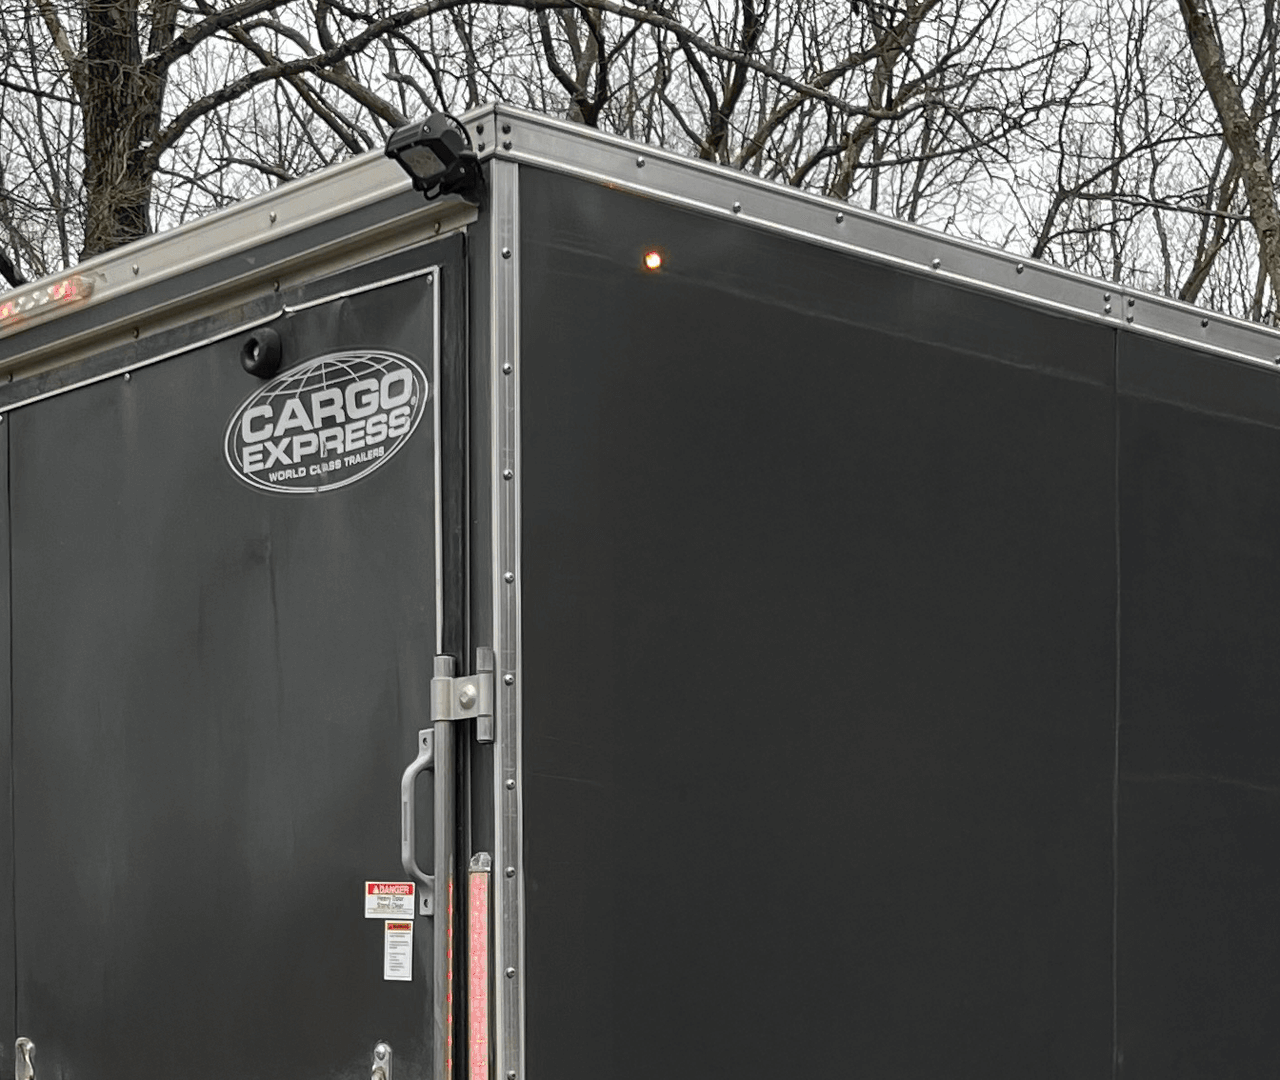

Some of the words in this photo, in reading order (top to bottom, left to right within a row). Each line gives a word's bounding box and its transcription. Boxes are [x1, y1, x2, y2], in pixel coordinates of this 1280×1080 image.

[241, 368, 413, 444] CARGO
[242, 405, 411, 474] EXPRESS
[269, 467, 306, 482] WORLD
[344, 446, 385, 467] TRAILERS
[380, 885, 409, 894] DANGER
